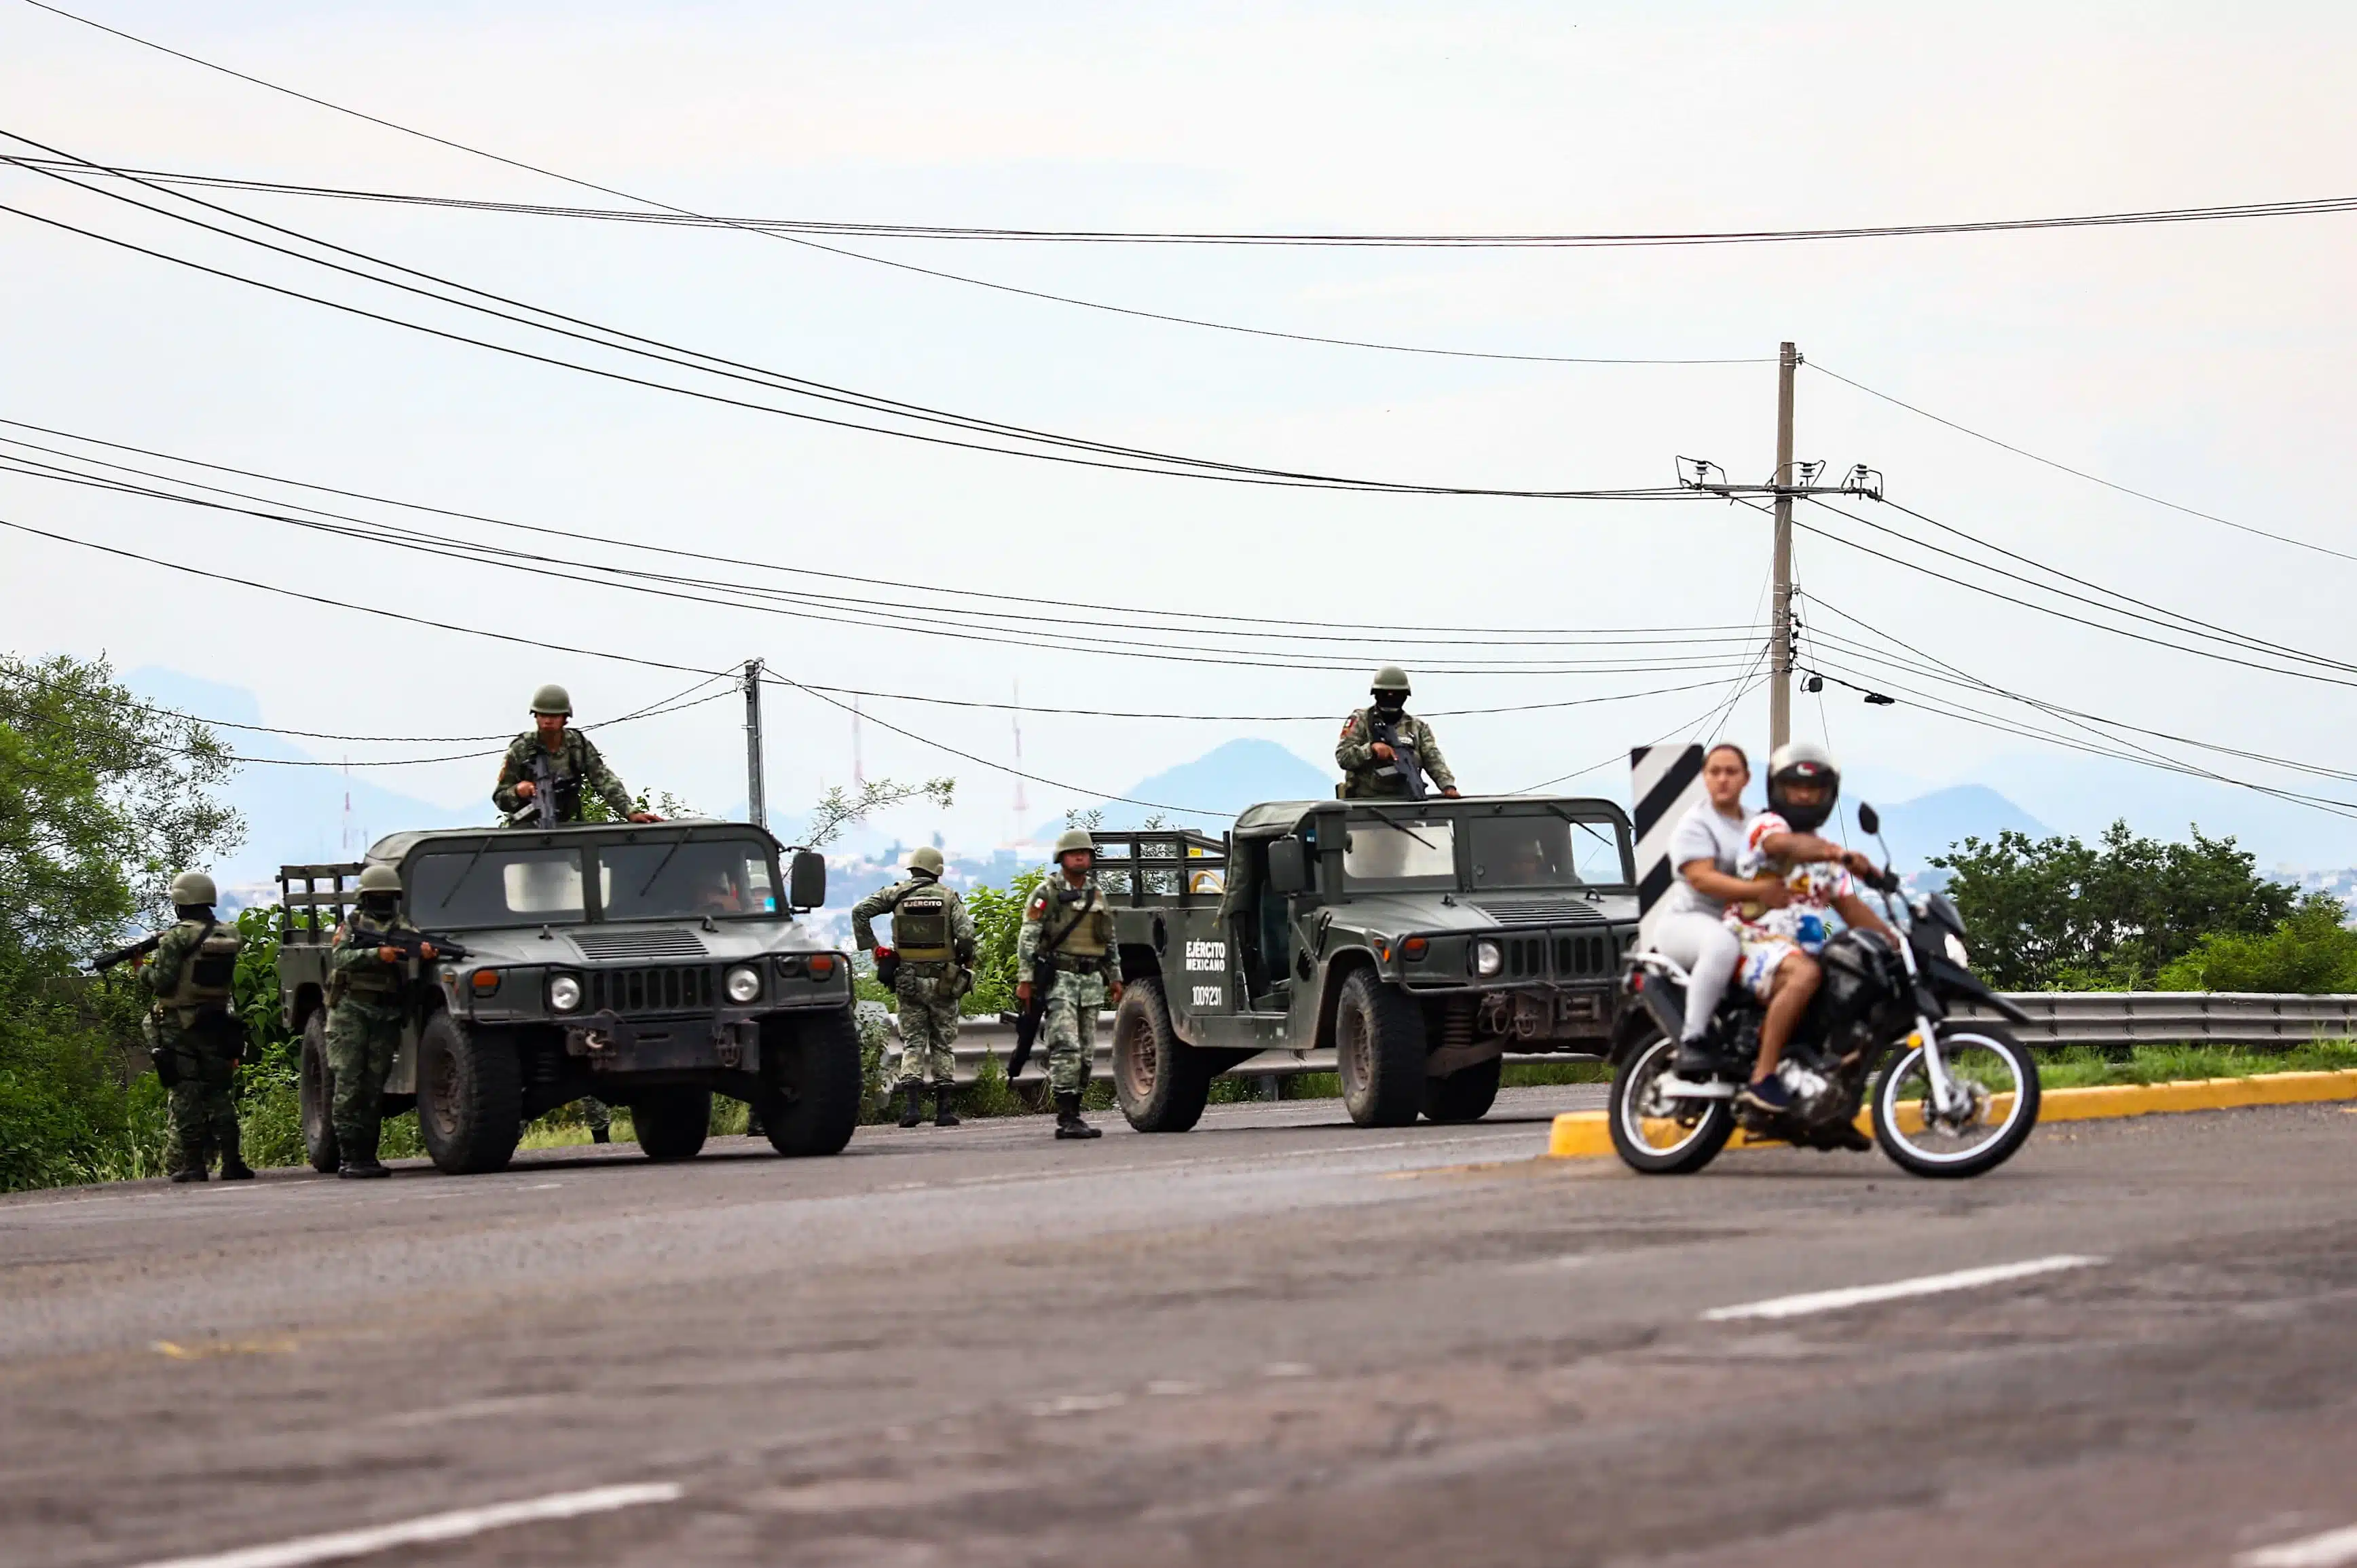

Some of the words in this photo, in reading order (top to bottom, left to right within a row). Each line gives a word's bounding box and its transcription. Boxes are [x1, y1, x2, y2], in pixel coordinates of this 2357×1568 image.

[1185, 937, 1225, 958] EJÉRCITO
[1185, 958, 1225, 971] MEXICANO
[1192, 986, 1222, 1006] 1009231
